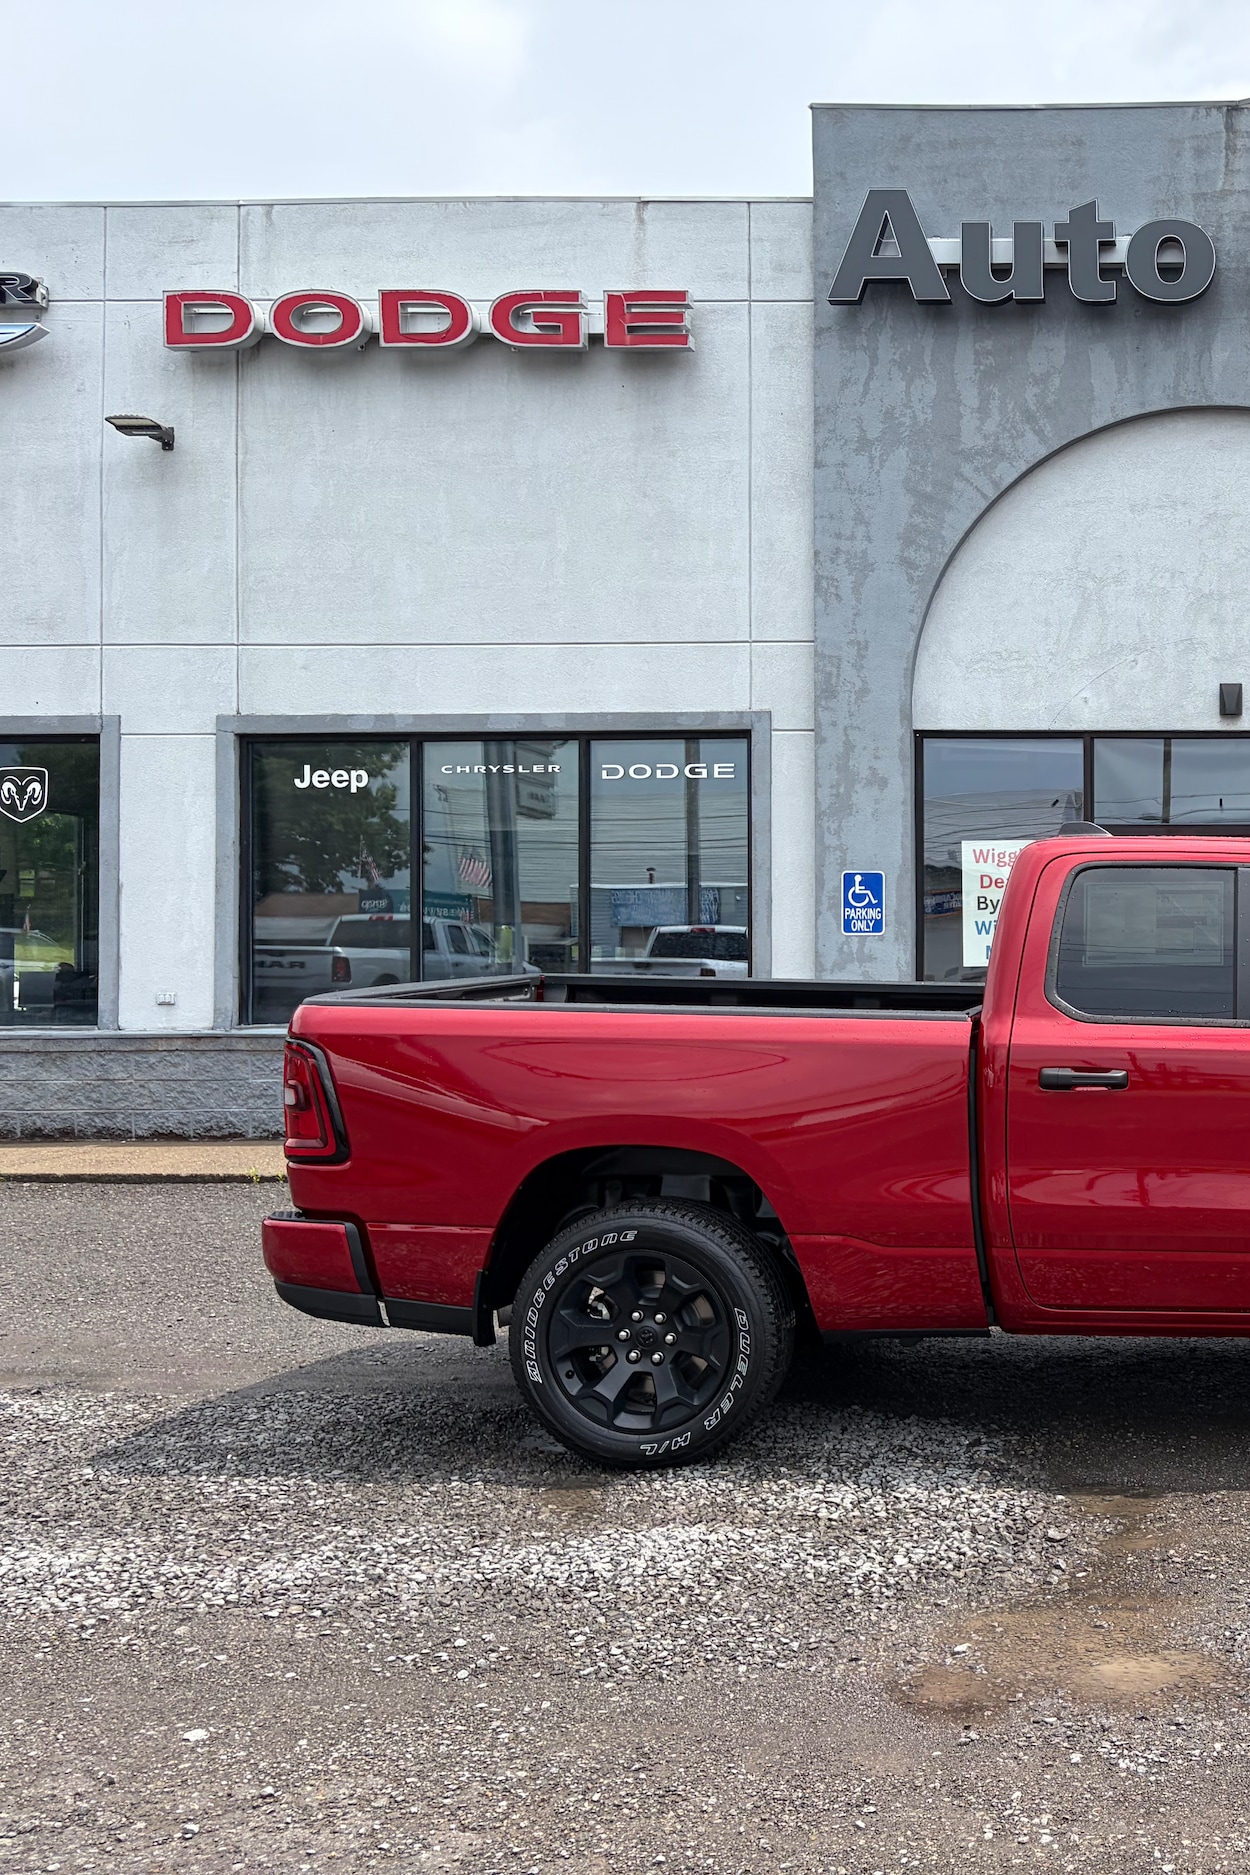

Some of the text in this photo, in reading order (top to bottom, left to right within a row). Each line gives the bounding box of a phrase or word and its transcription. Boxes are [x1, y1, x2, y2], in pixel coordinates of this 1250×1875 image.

[826, 186, 1217, 306] Auto
[162, 288, 697, 352] DODGE
[293, 764, 369, 793] Jeep
[440, 764, 562, 774] CHRYSLER
[601, 763, 736, 780] DODGE
[972, 848, 1020, 868] Wigg
[979, 874, 1008, 889] De
[844, 907, 882, 920] PARKING
[977, 895, 1000, 914] By
[850, 920, 876, 932] ONLY
[524, 1230, 638, 1384] BRIDGESTONE
[639, 1307, 751, 1456] DUELER H/L
